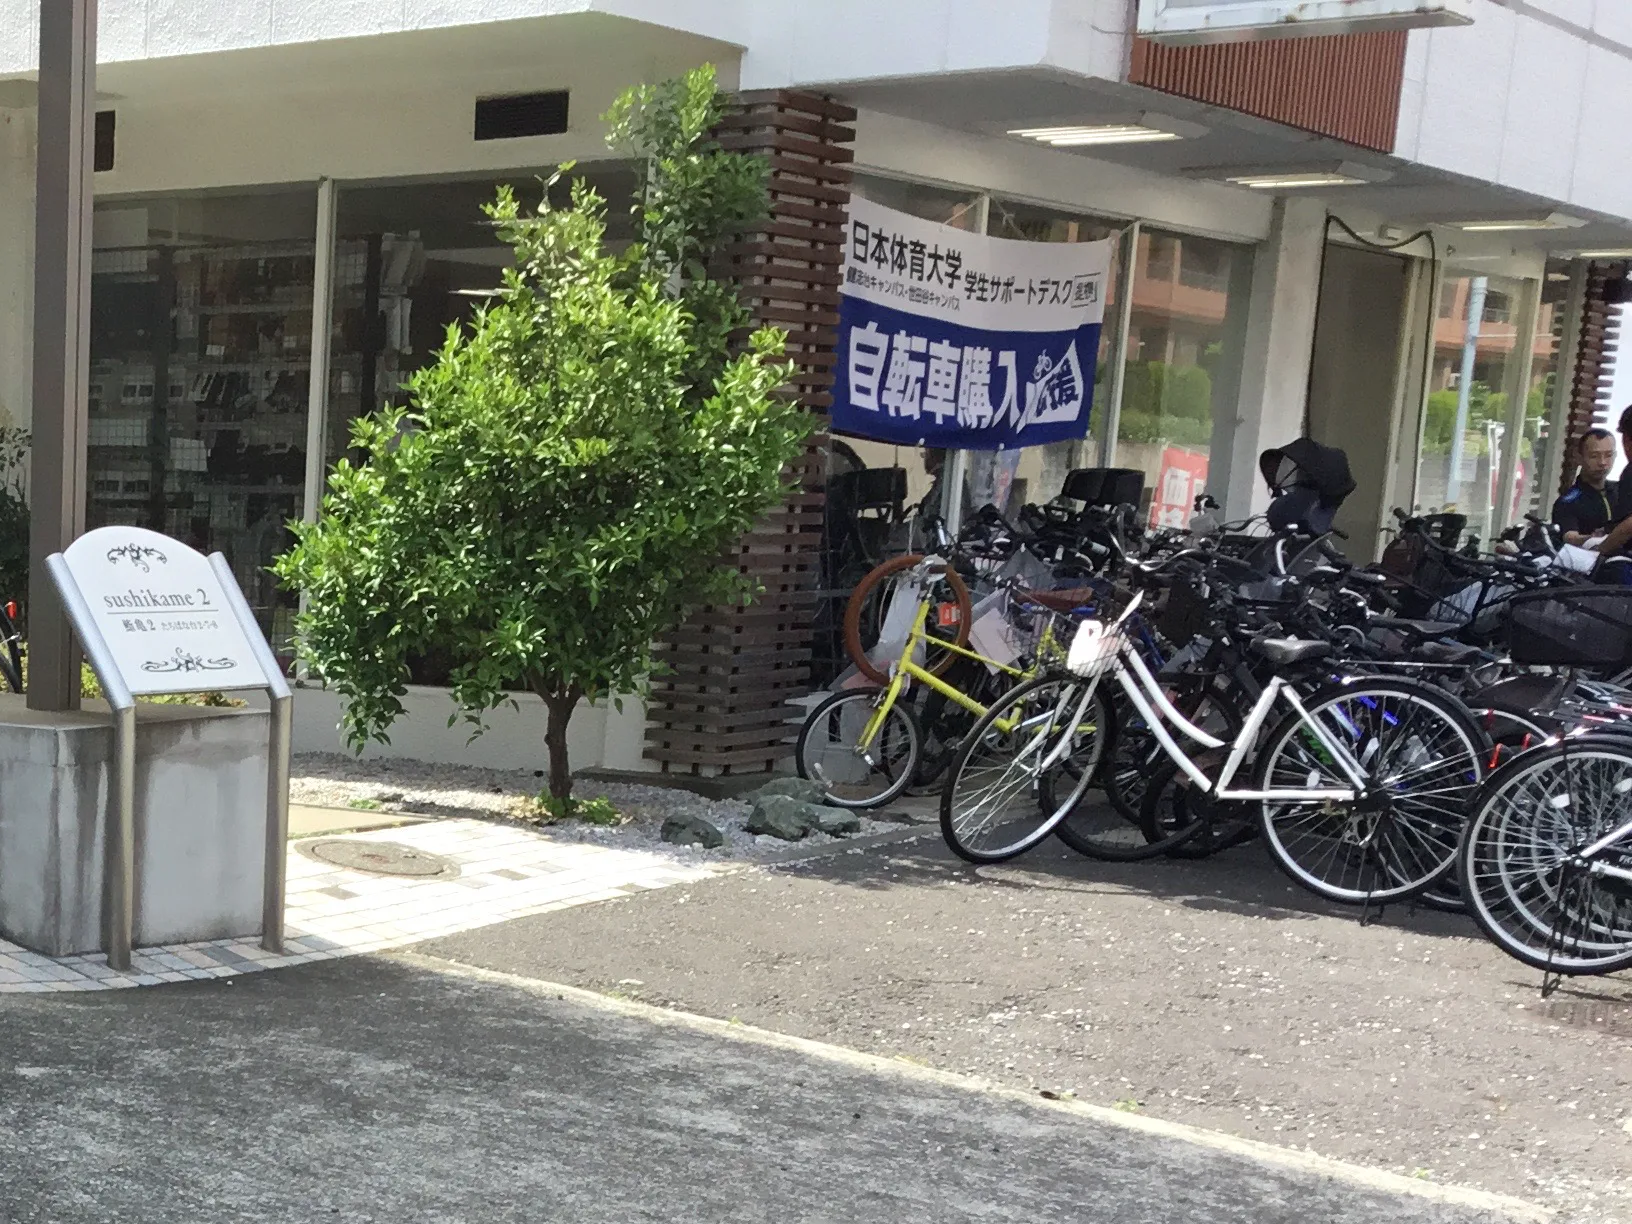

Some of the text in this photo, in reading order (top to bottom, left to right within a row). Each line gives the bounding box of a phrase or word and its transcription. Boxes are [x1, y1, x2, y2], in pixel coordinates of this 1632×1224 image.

[853, 220, 962, 289] 日本体育大学
[103, 588, 211, 608] sushikame 2
